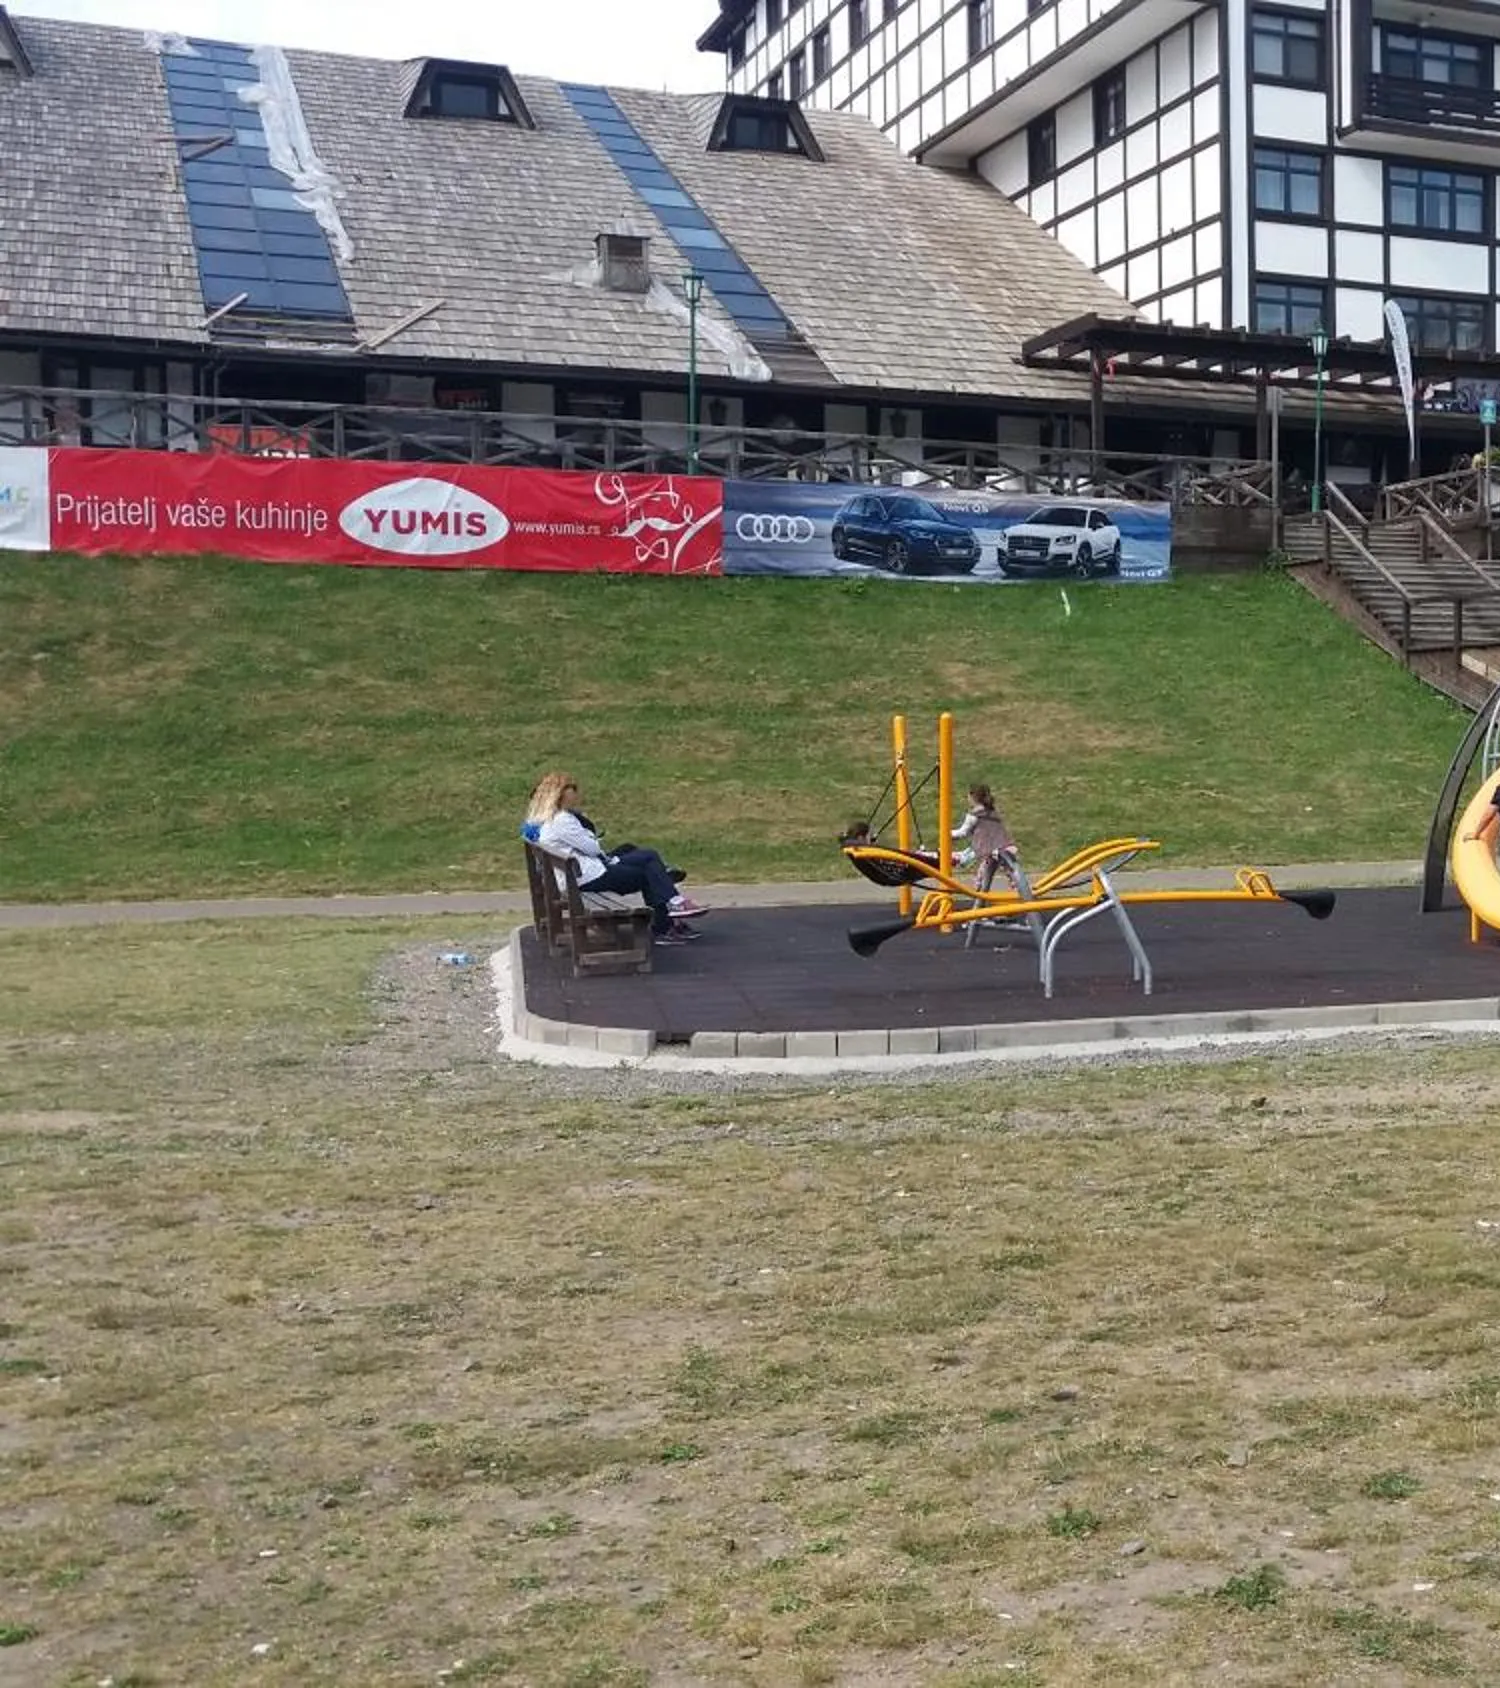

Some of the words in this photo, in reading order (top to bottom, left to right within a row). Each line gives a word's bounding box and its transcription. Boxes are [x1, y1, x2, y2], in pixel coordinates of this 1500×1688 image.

[57, 493, 157, 532] Prijatelj
[165, 498, 226, 527] vaše
[236, 500, 328, 537] kuhinje
